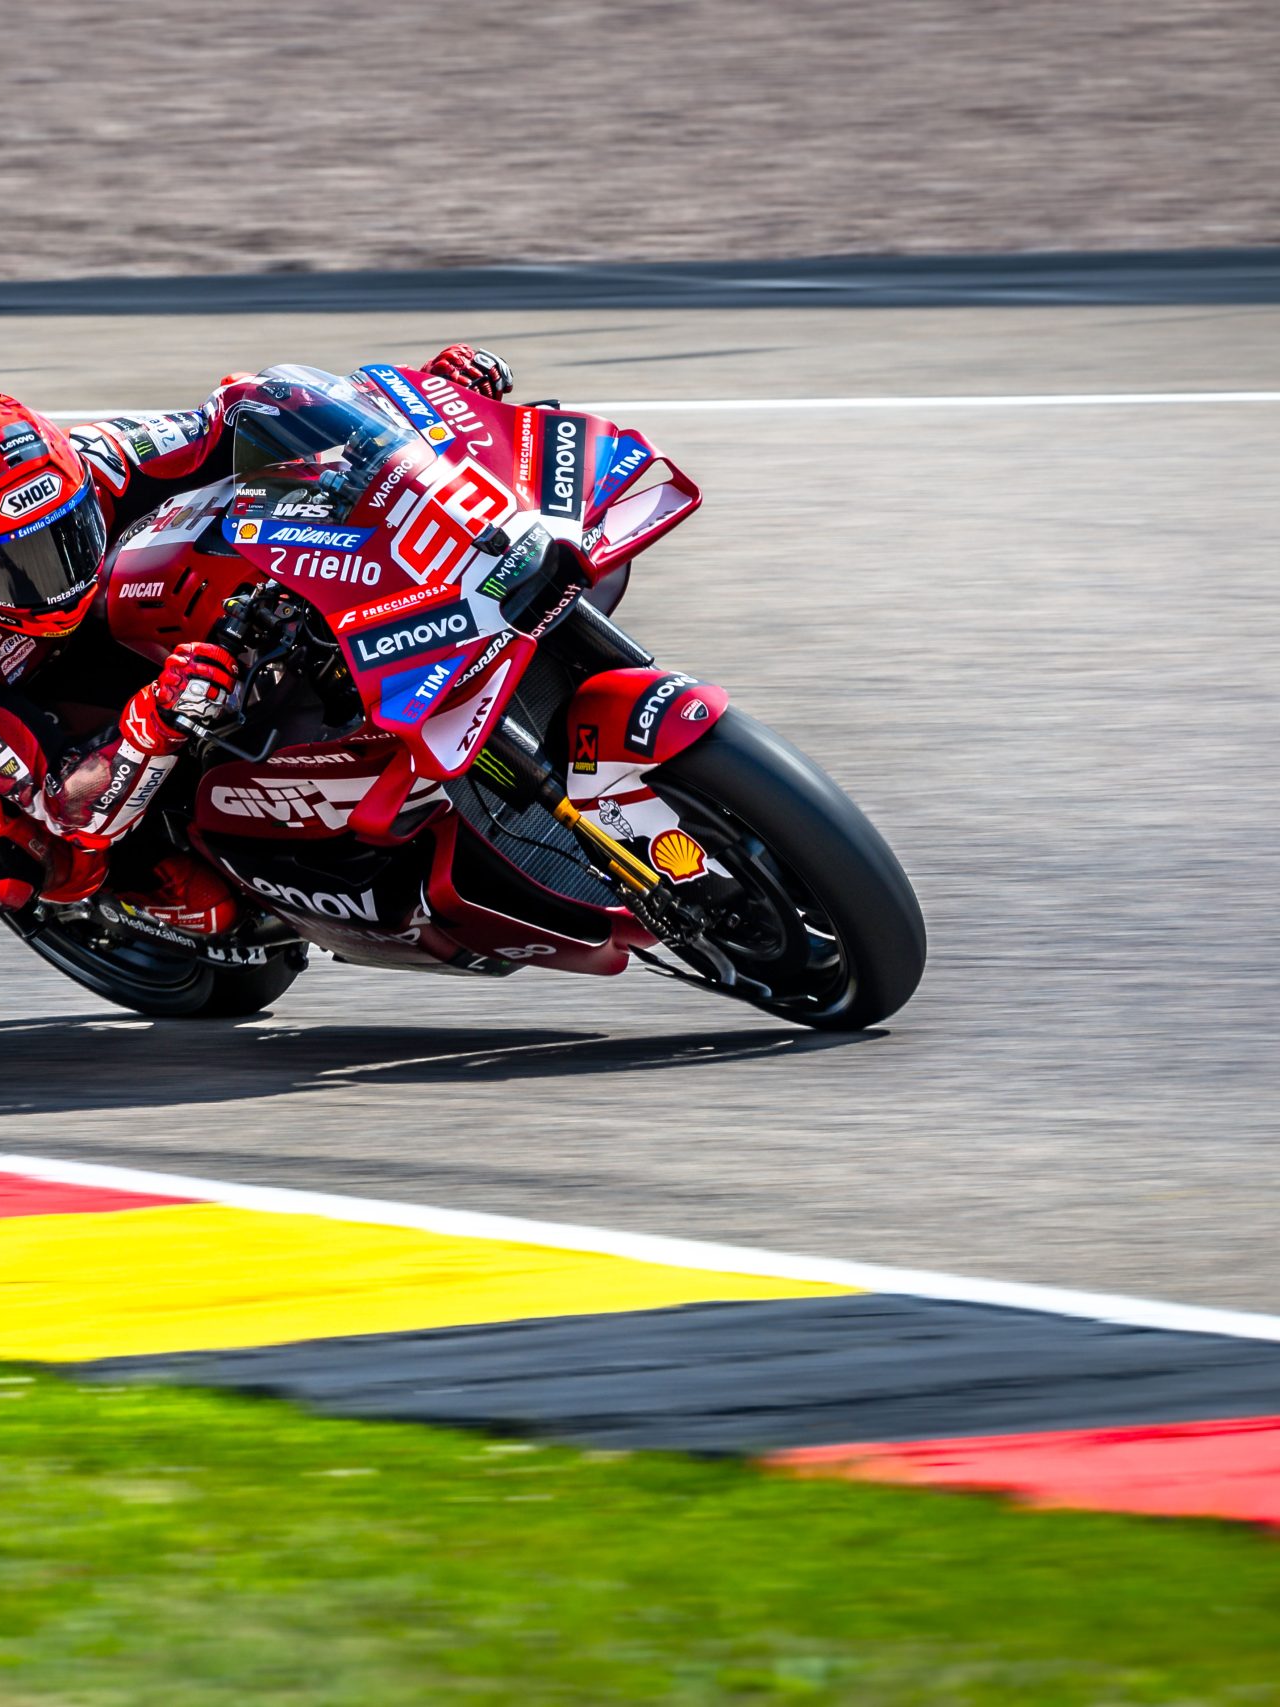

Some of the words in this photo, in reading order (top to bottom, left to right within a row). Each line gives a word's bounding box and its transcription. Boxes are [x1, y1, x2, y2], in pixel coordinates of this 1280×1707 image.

[370, 369, 433, 418] ADVANCE
[421, 377, 485, 433] riello
[0, 434, 35, 451] Lenovo
[520, 410, 533, 481] FRECCIAROSSA
[548, 421, 577, 513] Lenovo
[611, 448, 647, 477] TIM
[7, 477, 56, 513] SHOEI
[236, 488, 267, 497] MARQUEZ
[272, 503, 334, 518] WRS
[18, 521, 45, 538] Estrella
[44, 508, 67, 525] Galicia
[268, 527, 361, 548] ADVANCE
[293, 550, 382, 586] riello
[47, 581, 86, 605] Insta360
[119, 582, 165, 598] DUCATI
[362, 584, 448, 617] FRECCIAROSSA
[531, 583, 582, 638] aruba.it
[357, 614, 468, 661] Lenovo
[454, 631, 514, 688] CARRERA
[416, 664, 451, 699] TIM
[457, 697, 494, 751] ZYN
[267, 753, 356, 764] DUCATI
[95, 764, 131, 810] Lenovo
[126, 767, 167, 808] Unipol
[211, 785, 314, 821] GIVI
[120, 914, 197, 949] Reflexallen
